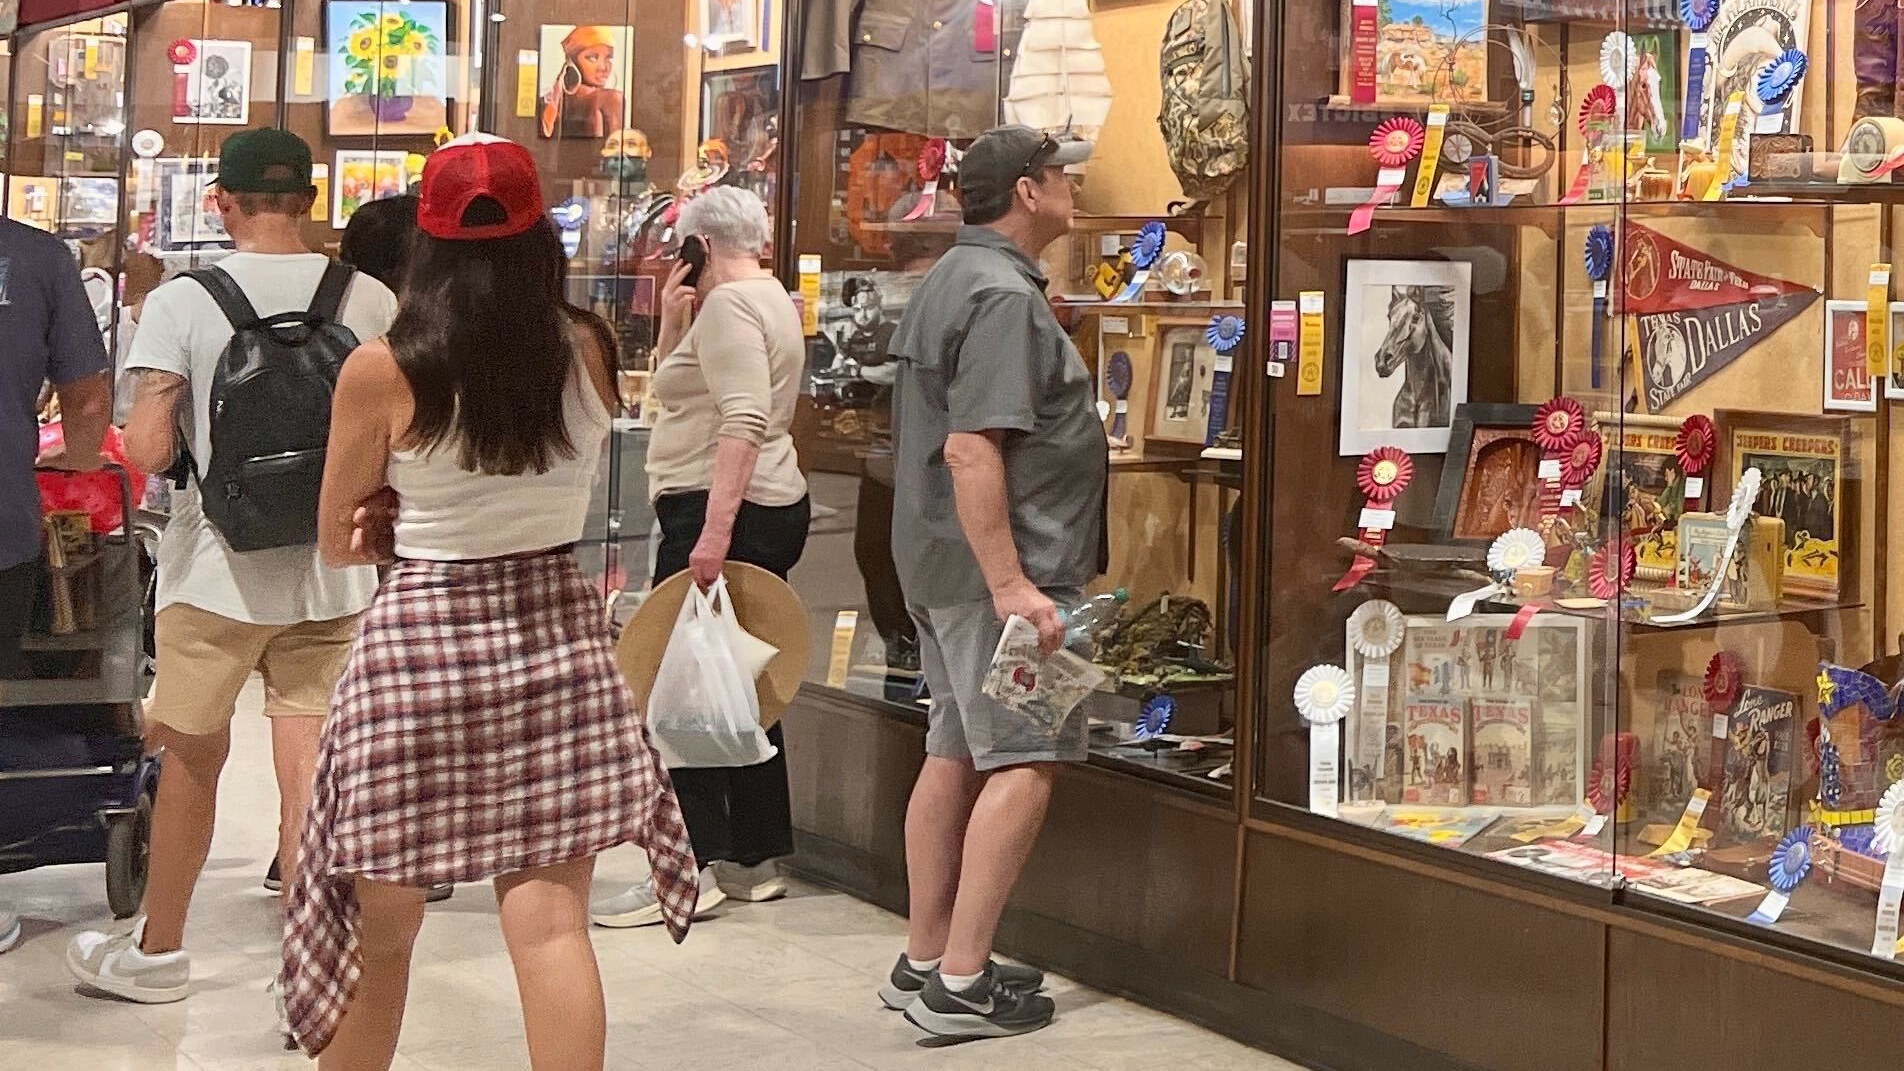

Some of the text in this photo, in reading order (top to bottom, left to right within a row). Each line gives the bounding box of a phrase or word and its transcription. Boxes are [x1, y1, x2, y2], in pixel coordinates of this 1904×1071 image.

[1668, 249, 1704, 280] STATE
[1689, 280, 1721, 291] DALLAS
[1640, 311, 1681, 339] TEXAS
[1684, 303, 1762, 375] DALLAS
[1407, 705, 1461, 725] TEXAS
[1472, 705, 1529, 725] TEXAS
[1748, 701, 1793, 732] RANGER
